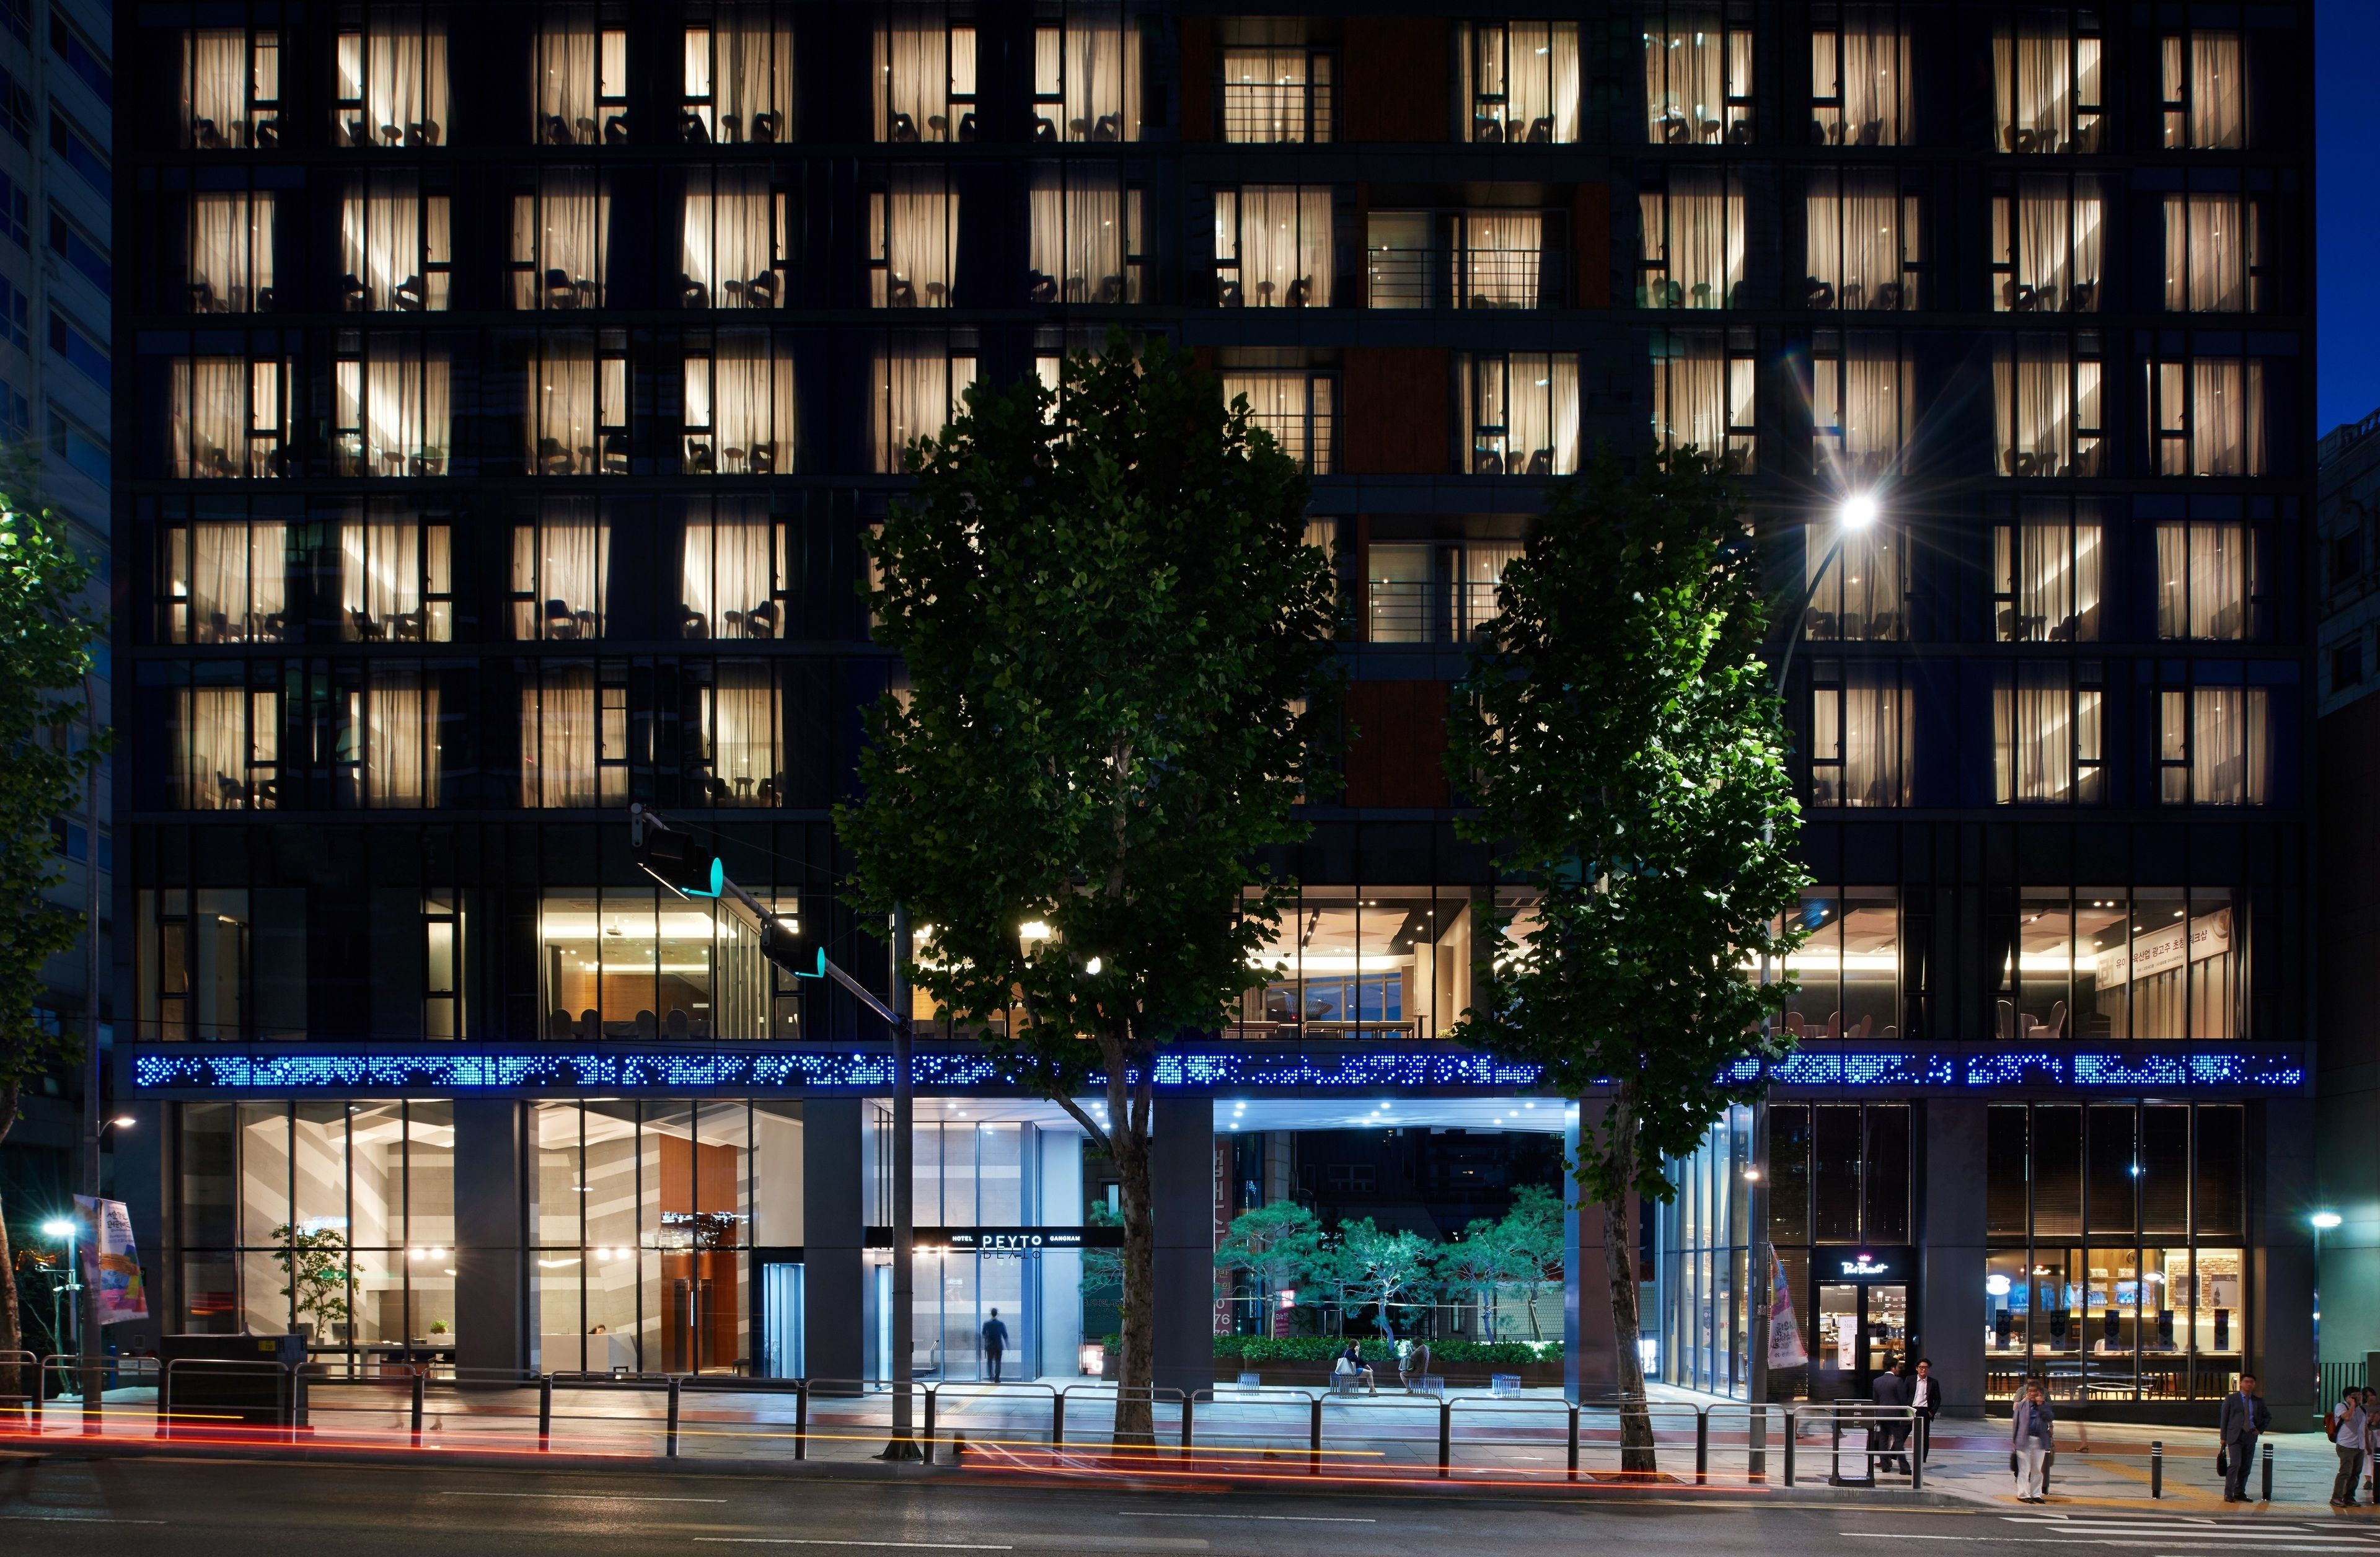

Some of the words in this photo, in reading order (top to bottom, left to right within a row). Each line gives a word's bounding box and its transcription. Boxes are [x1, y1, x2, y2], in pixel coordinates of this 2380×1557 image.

[2116, 950, 2150, 969] 유육산업
[2152, 942, 2171, 957] 광고주
[982, 1235, 1042, 1248] PEYTO
